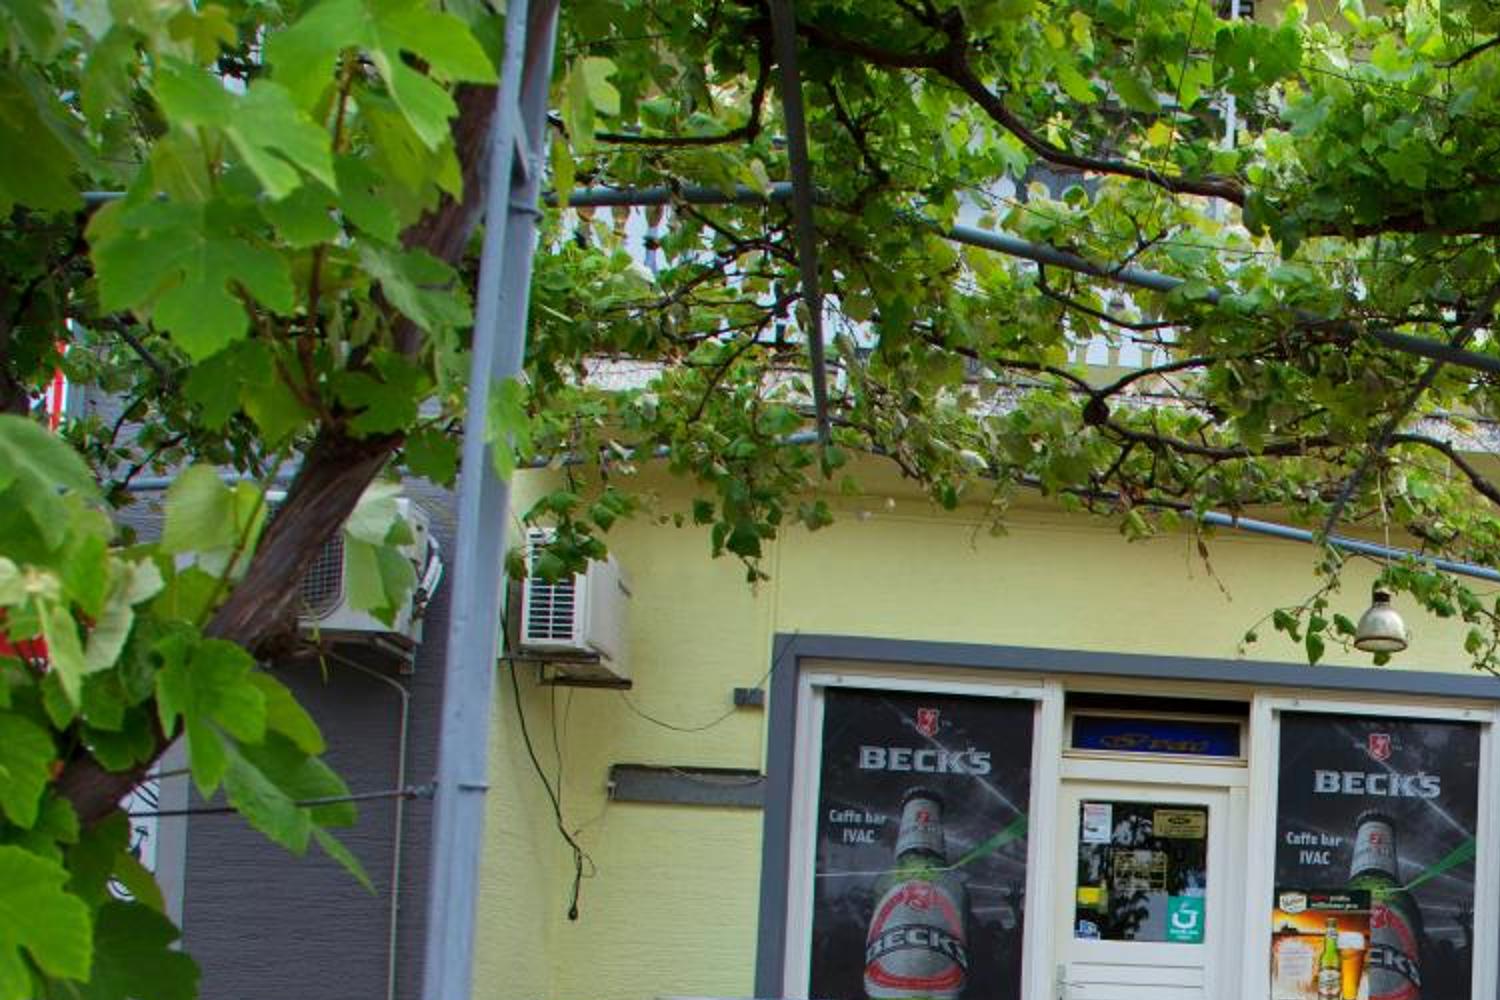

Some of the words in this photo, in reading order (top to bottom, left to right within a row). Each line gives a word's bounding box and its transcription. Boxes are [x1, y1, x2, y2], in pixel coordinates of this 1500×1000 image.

[859, 746, 991, 776] BECK'S
[1313, 769, 1441, 798] BECK'S
[829, 809, 862, 824] Caffe
[865, 810, 887, 825] bar
[843, 828, 875, 843] IVAC
[1286, 832, 1318, 846] Caffe
[1321, 832, 1343, 846] bar
[1299, 851, 1331, 866] IVAC
